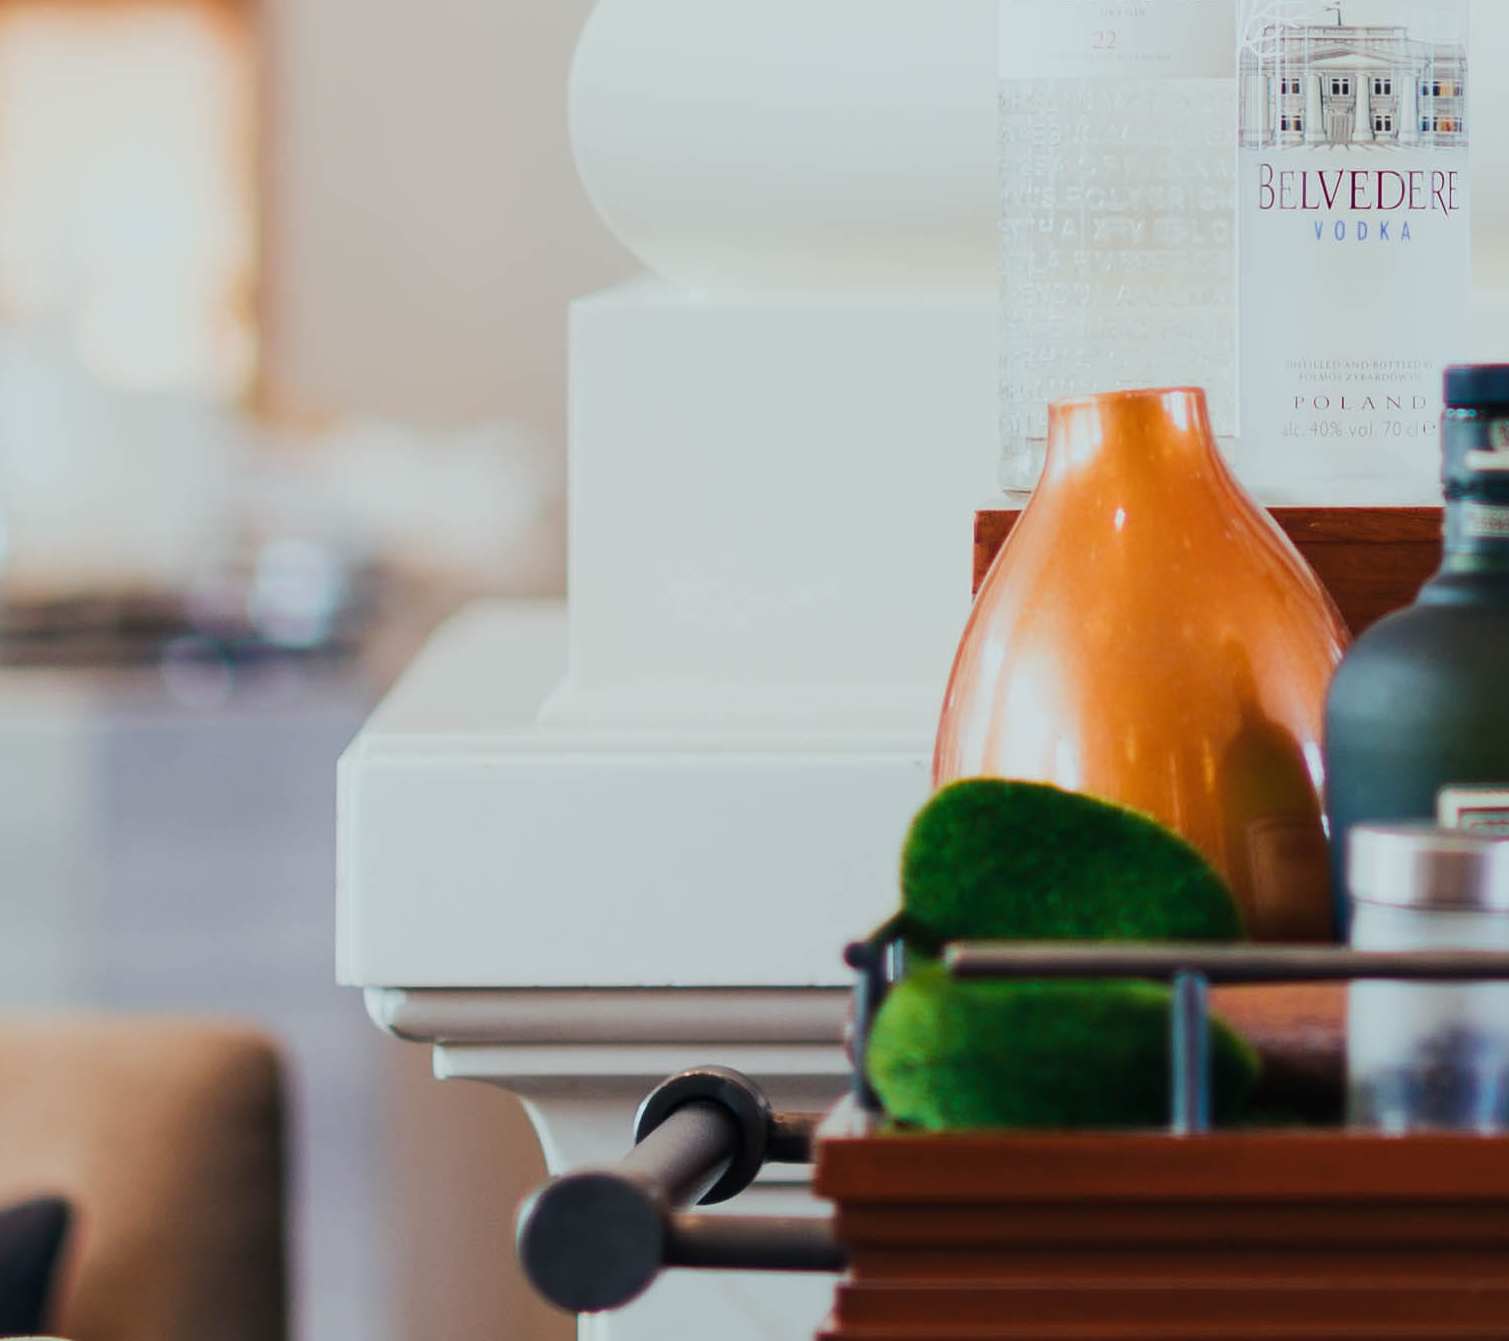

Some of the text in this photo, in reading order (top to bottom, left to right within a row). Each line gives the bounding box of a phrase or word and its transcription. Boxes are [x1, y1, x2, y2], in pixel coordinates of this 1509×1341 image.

[1091, 30, 1116, 50] 22
[1258, 163, 1460, 217] BELVEDERE
[1313, 220, 1411, 241] VODKA
[1292, 395, 1427, 411] POLAND
[1309, 421, 1343, 438] 40%
[1383, 421, 1403, 438] 70
